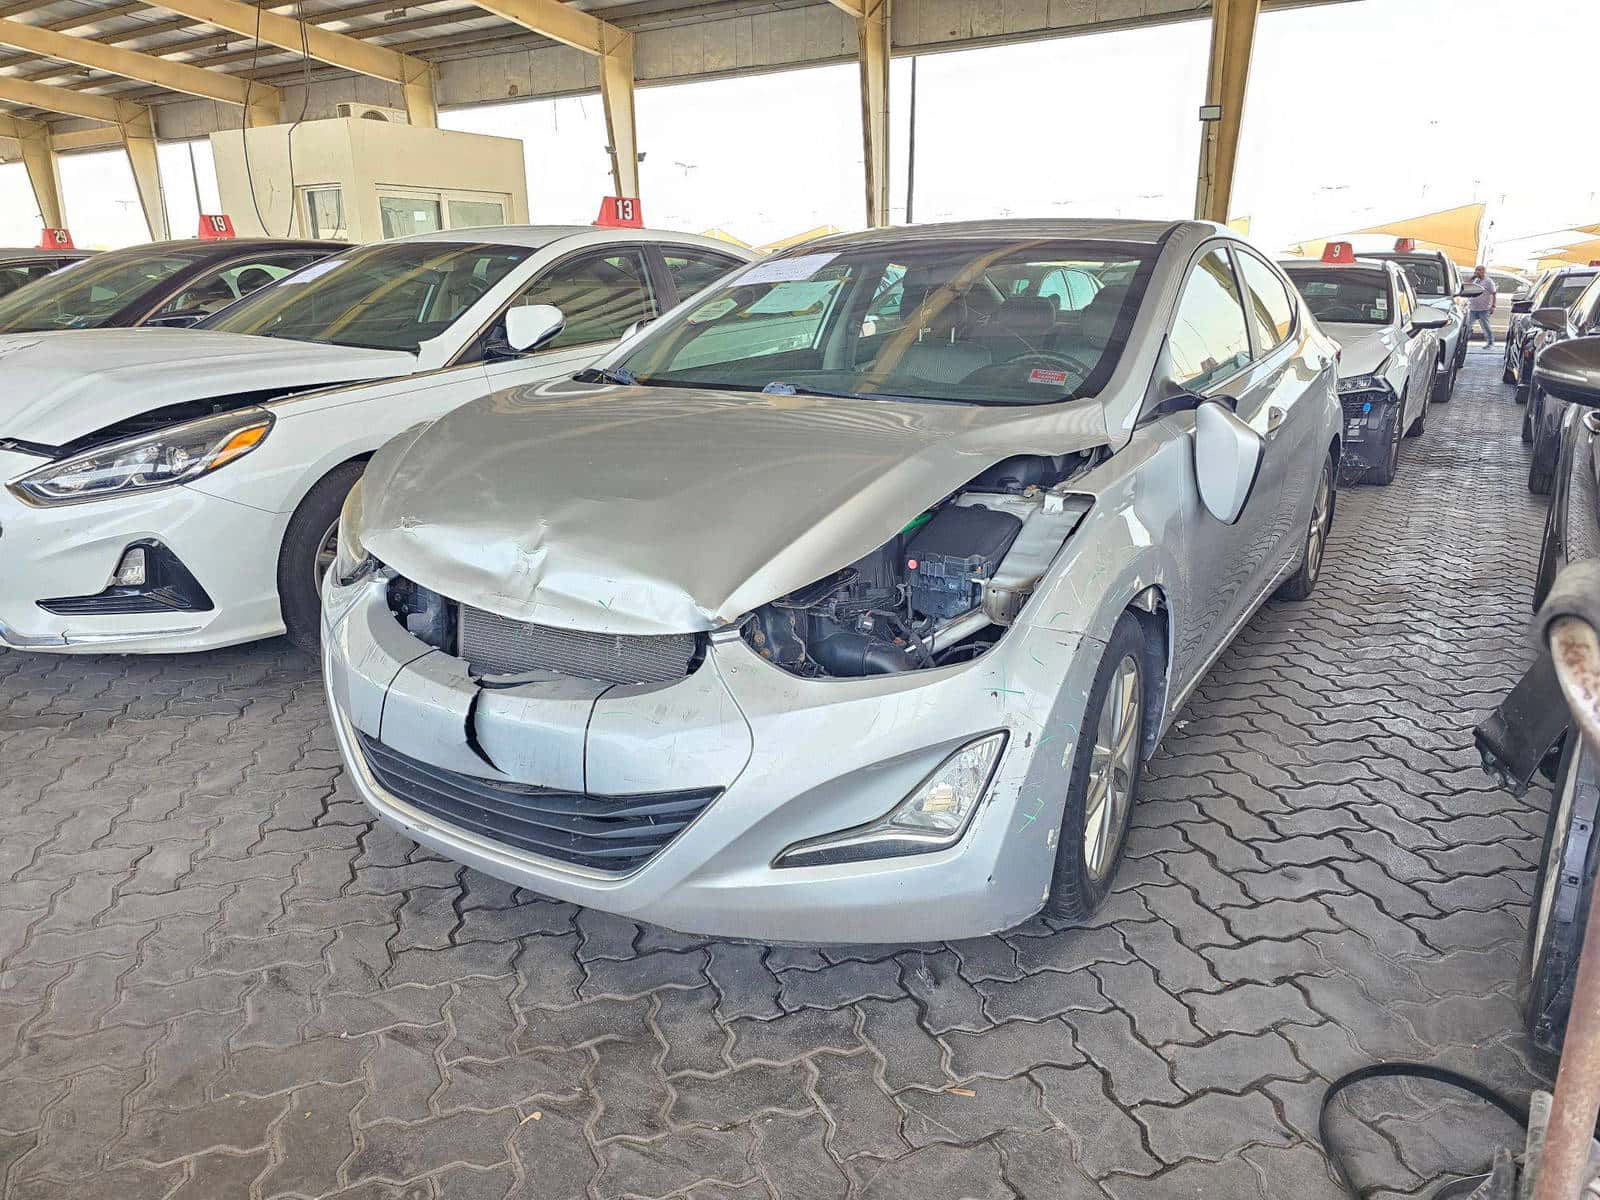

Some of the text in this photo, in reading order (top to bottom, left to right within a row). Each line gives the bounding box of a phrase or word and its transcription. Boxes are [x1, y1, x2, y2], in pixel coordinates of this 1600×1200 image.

[616, 199, 633, 220] 13
[211, 216, 227, 231] 19
[1333, 244, 1341, 258] 9
